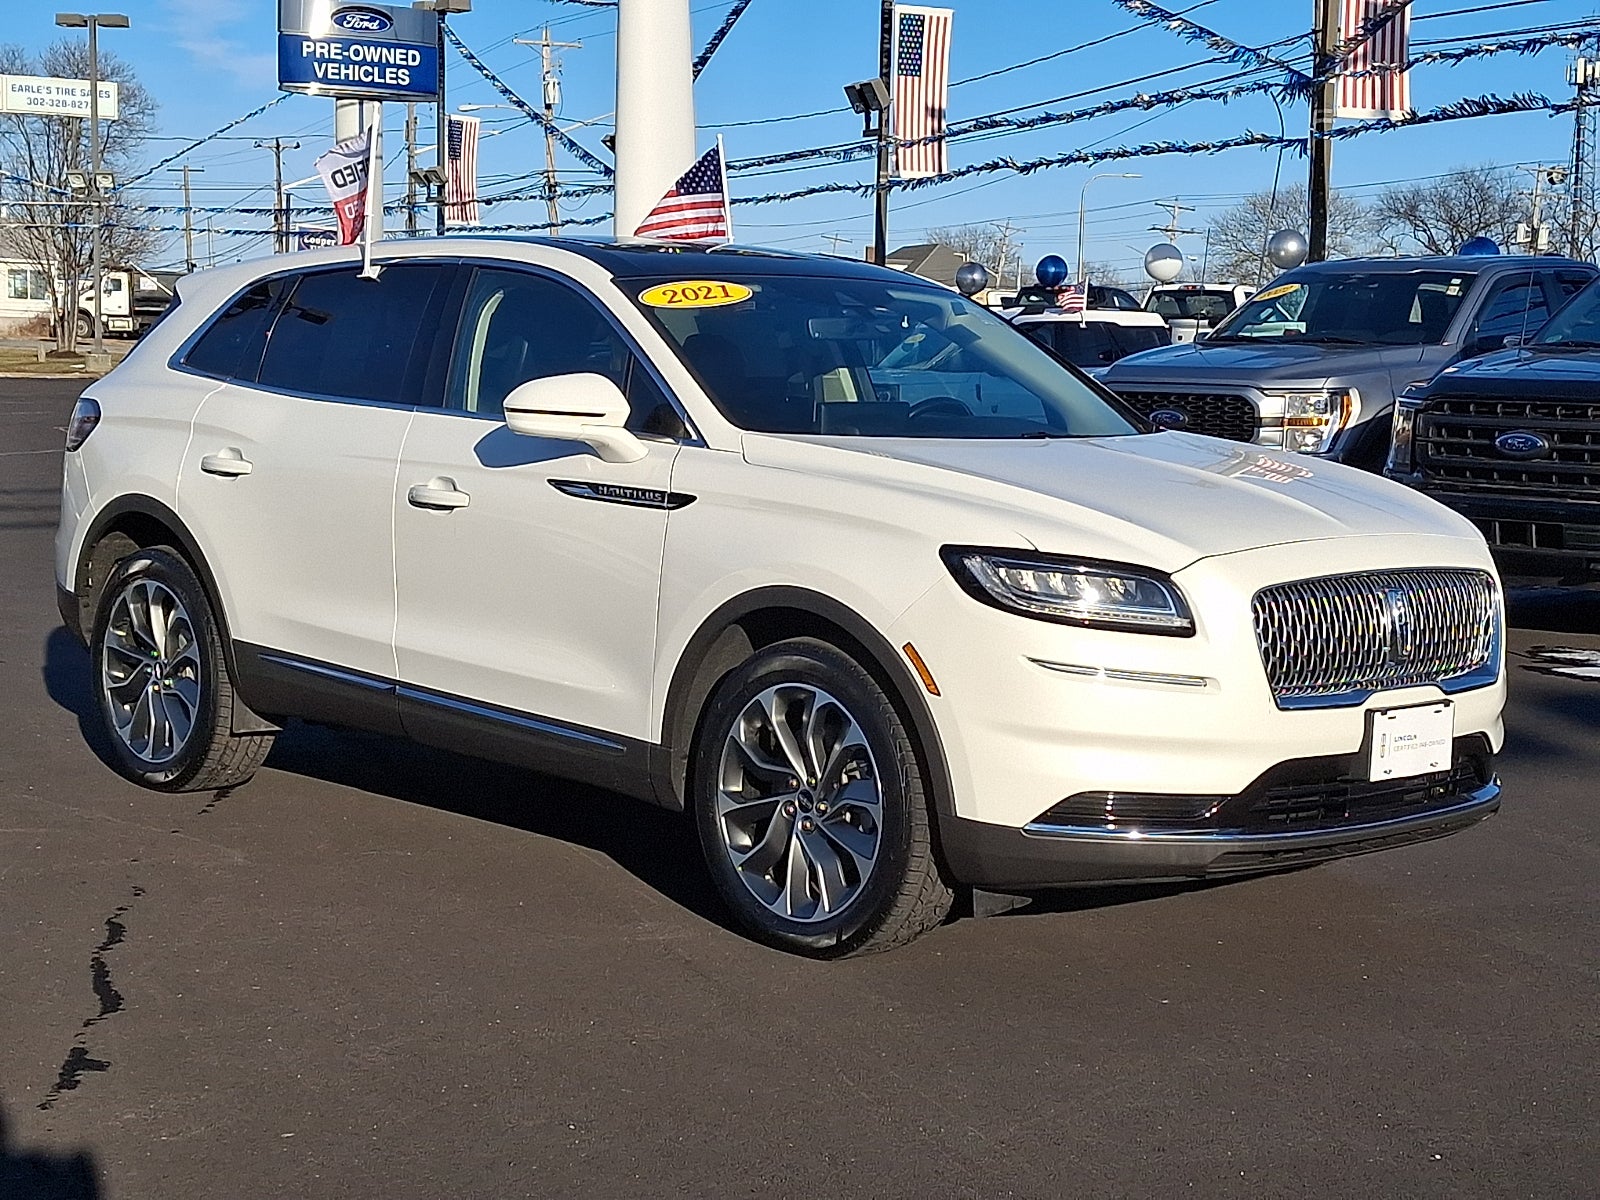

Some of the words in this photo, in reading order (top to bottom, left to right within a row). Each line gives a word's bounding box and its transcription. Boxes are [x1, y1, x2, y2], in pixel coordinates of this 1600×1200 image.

[342, 13, 380, 31] Ford
[302, 40, 421, 67] PRE-OWNED
[313, 61, 411, 86] VEHICLES
[11, 83, 52, 95] EARLE'S
[56, 87, 77, 97] TIRE
[80, 88, 111, 99] SAES
[26, 96, 92, 110] 302-328-827
[662, 284, 734, 304] 2021
[599, 485, 662, 501] NAUTILUS
